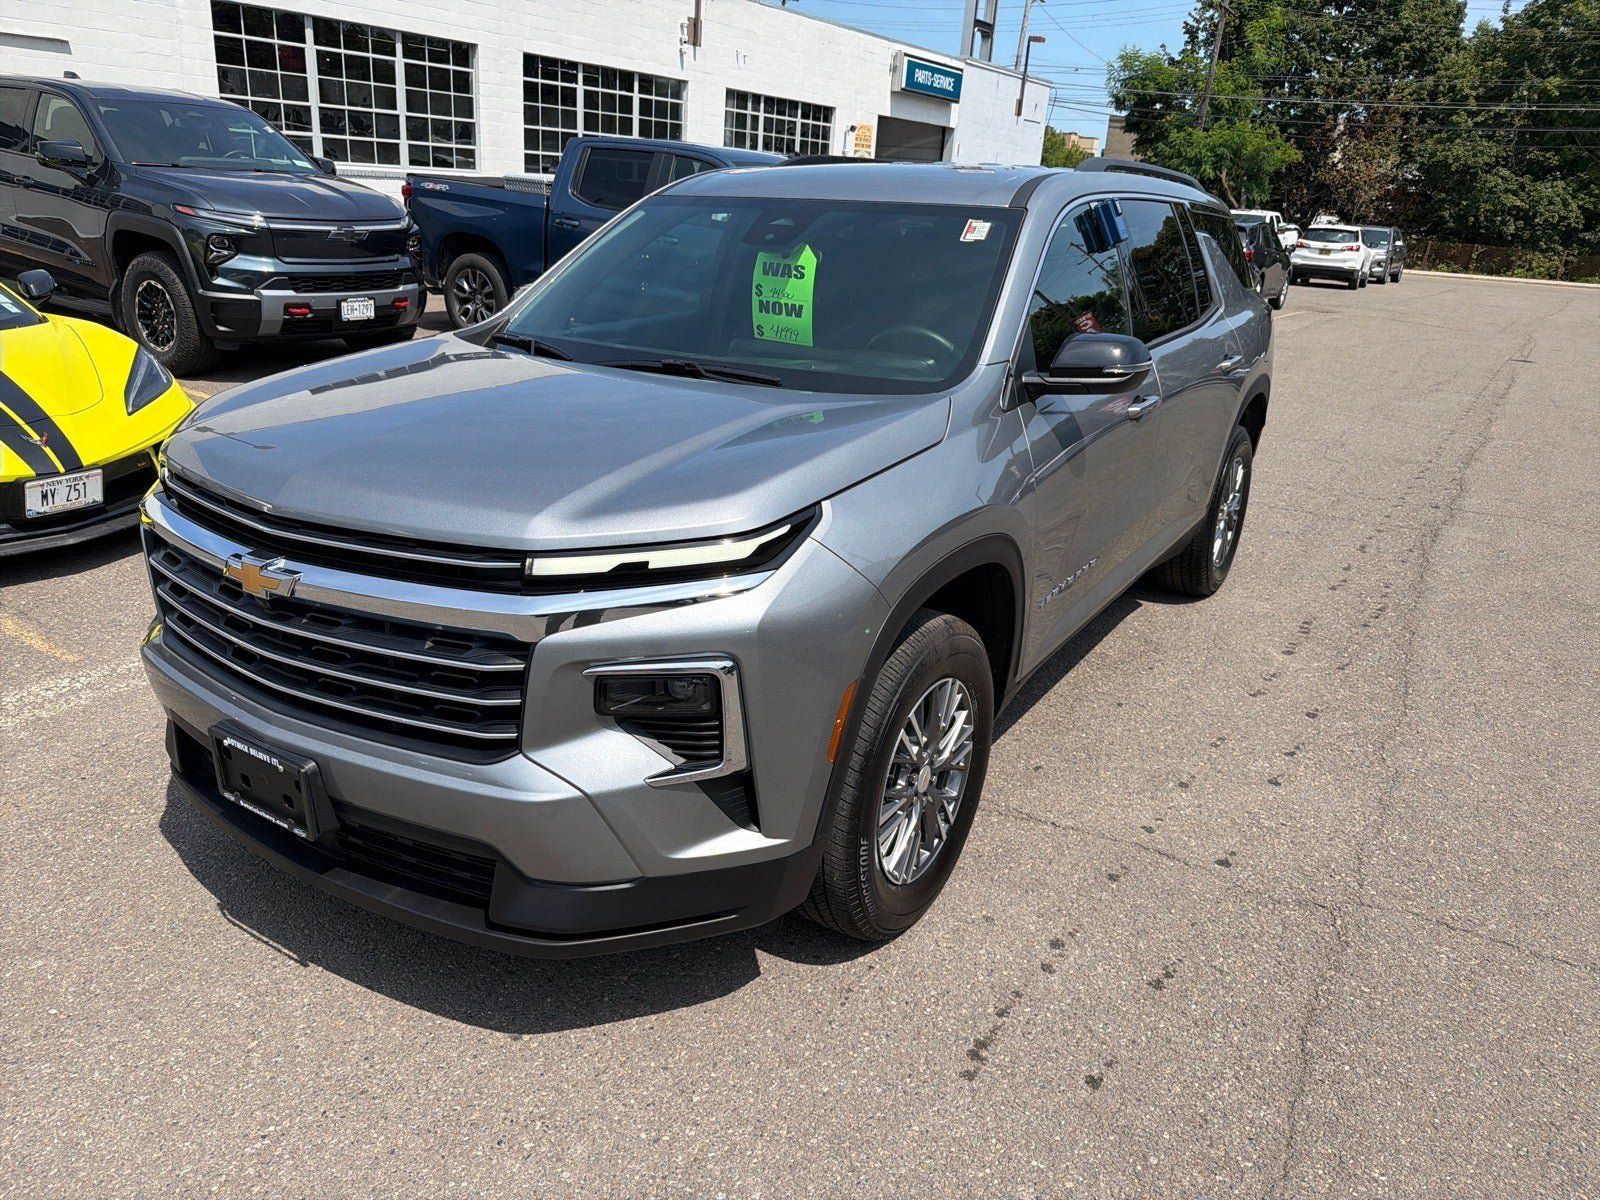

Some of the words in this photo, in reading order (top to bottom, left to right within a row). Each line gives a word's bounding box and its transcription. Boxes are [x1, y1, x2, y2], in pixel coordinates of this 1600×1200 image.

[762, 261, 806, 280] WAS
[755, 283, 763, 298] $
[758, 299, 804, 319] NOW
[756, 324, 765, 338] $
[46, 480, 63, 488] NEW
[65, 477, 84, 485] YORK
[41, 487, 57, 508] MY
[65, 481, 87, 503] Z51
